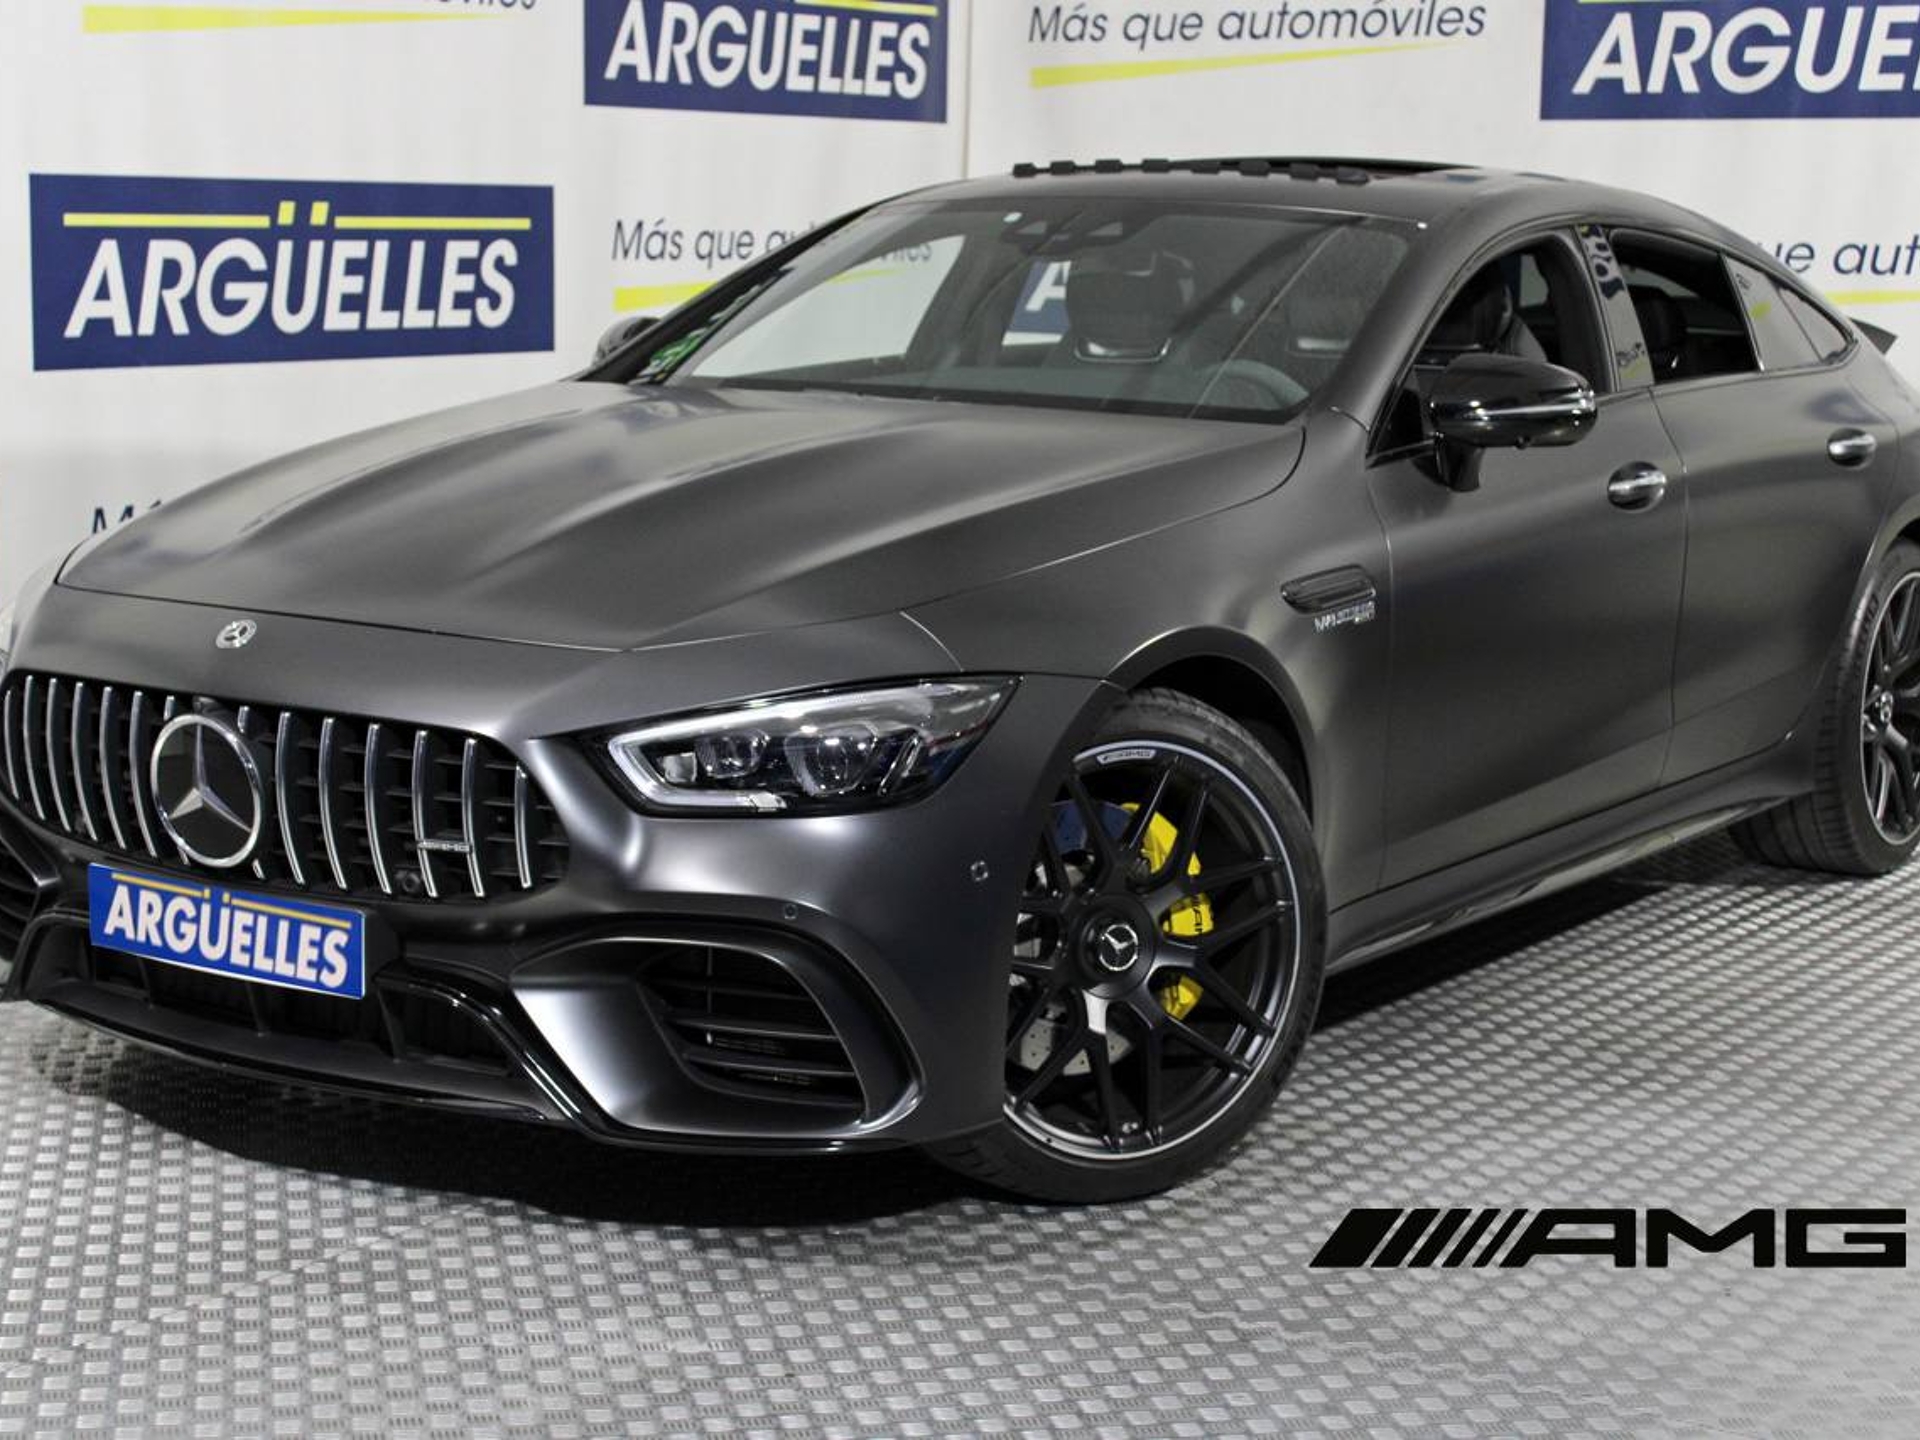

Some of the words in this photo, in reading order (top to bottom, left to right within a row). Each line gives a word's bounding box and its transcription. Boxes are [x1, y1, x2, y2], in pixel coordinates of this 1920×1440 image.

[1028, 4, 1108, 43] Más
[1122, 12, 1204, 51] que
[1217, 0, 1487, 41] automóviles
[63, 201, 519, 338] ARGÜELLES
[611, 219, 684, 261] Más
[695, 230, 754, 269] que
[103, 883, 349, 989] ARGÜELLES
